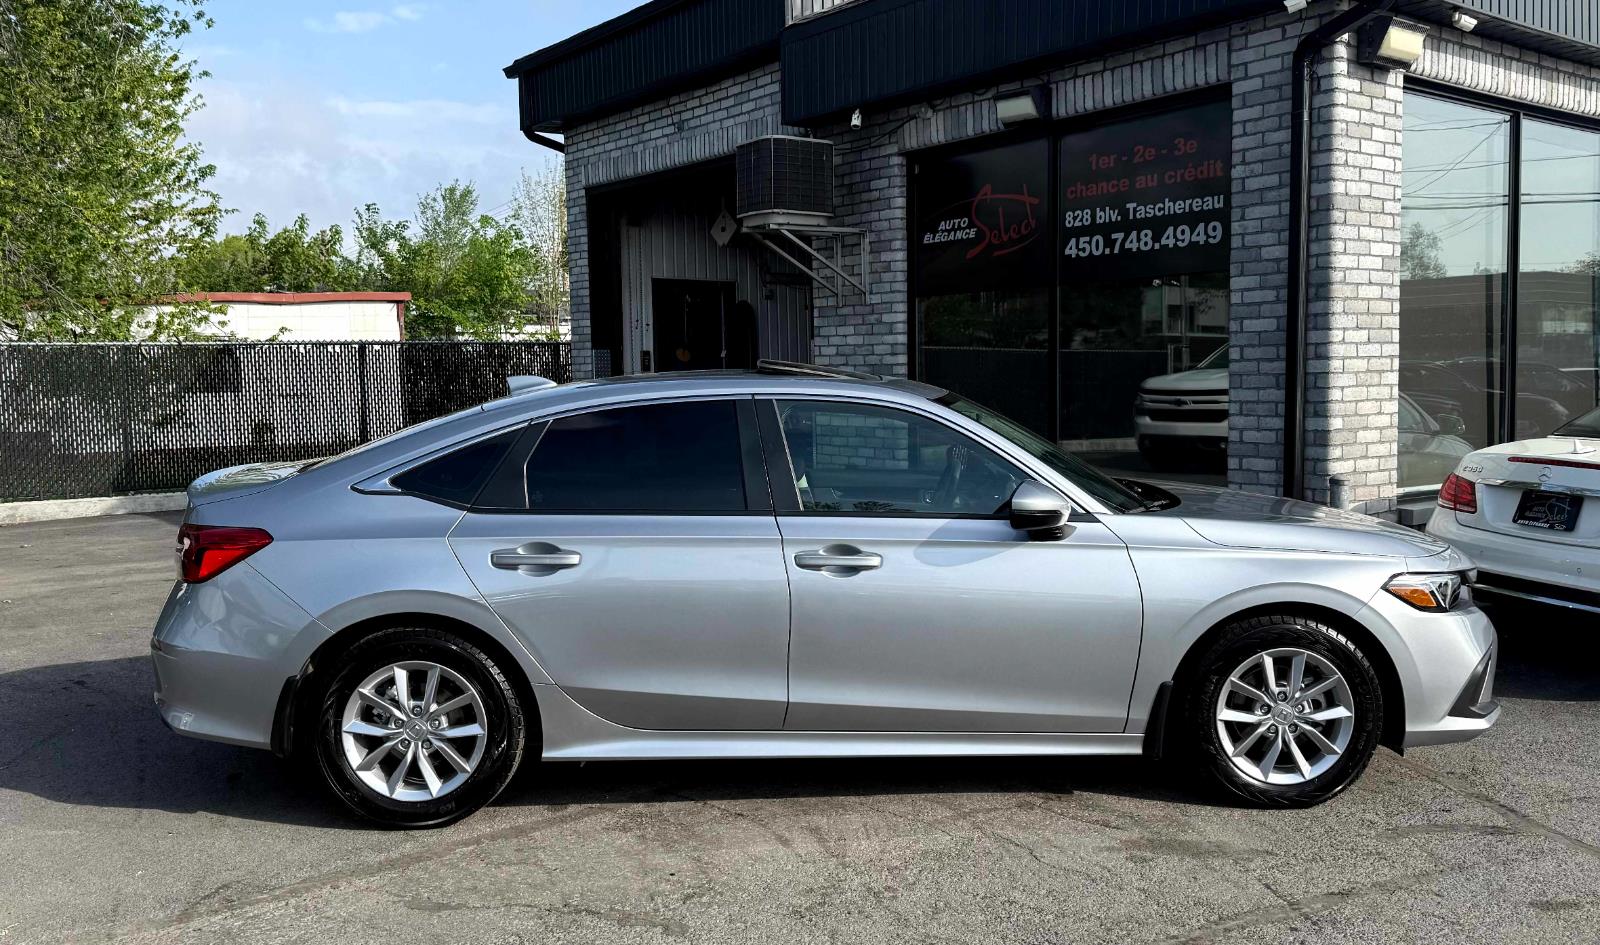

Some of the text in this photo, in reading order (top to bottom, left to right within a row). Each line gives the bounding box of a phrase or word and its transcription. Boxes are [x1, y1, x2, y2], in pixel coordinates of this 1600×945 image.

[1088, 153, 1117, 170] 1er
[1133, 145, 1156, 164] 2e
[1173, 137, 1199, 156] 3e
[1066, 160, 1225, 200] chance au crédit
[938, 217, 969, 231] AUTO
[965, 184, 1040, 262] Select
[1064, 194, 1225, 228] 828 blv. Taschereau
[922, 228, 978, 244] ÉLÉGANCE
[1064, 220, 1223, 259] 450.748.4949
